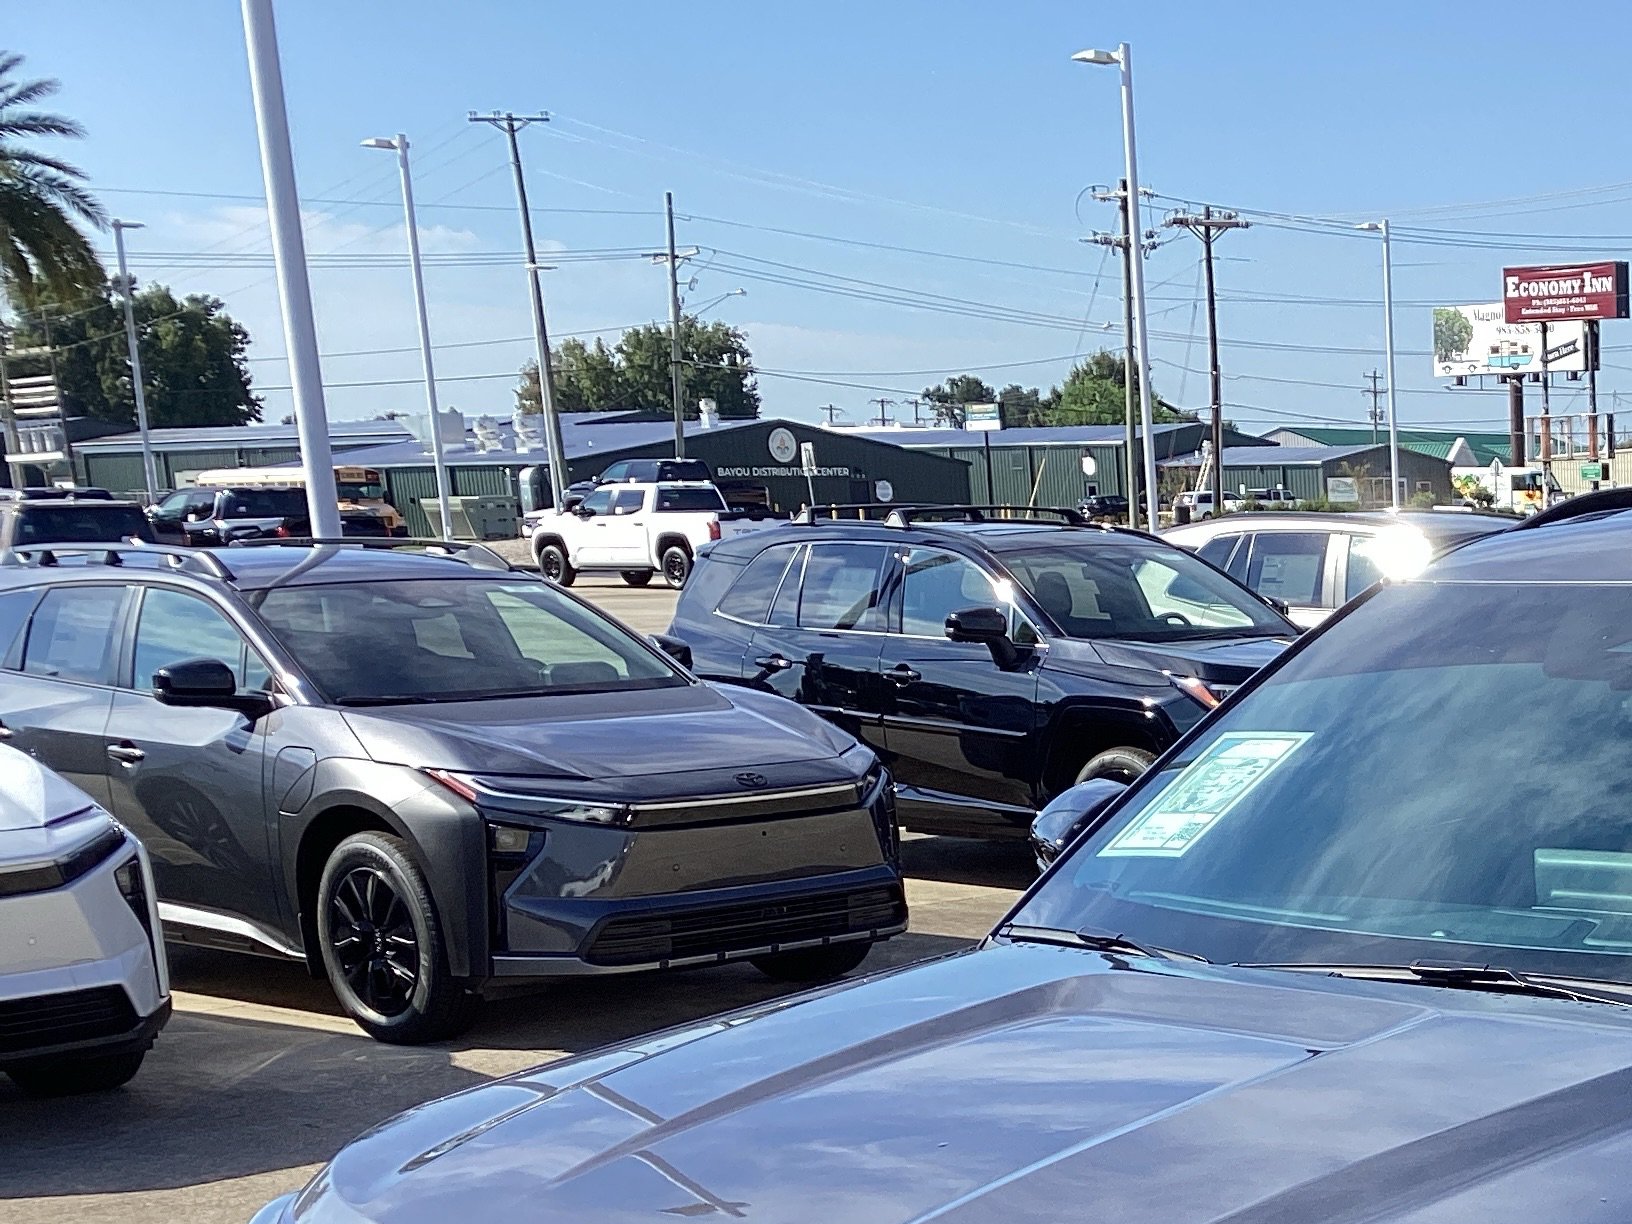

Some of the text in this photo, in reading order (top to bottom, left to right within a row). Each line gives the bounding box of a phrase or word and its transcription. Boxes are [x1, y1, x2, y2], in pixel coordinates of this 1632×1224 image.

[1474, 307, 1504, 321] Magnol
[717, 467, 849, 477] BAYOU DISTRIBUTI CENTER
